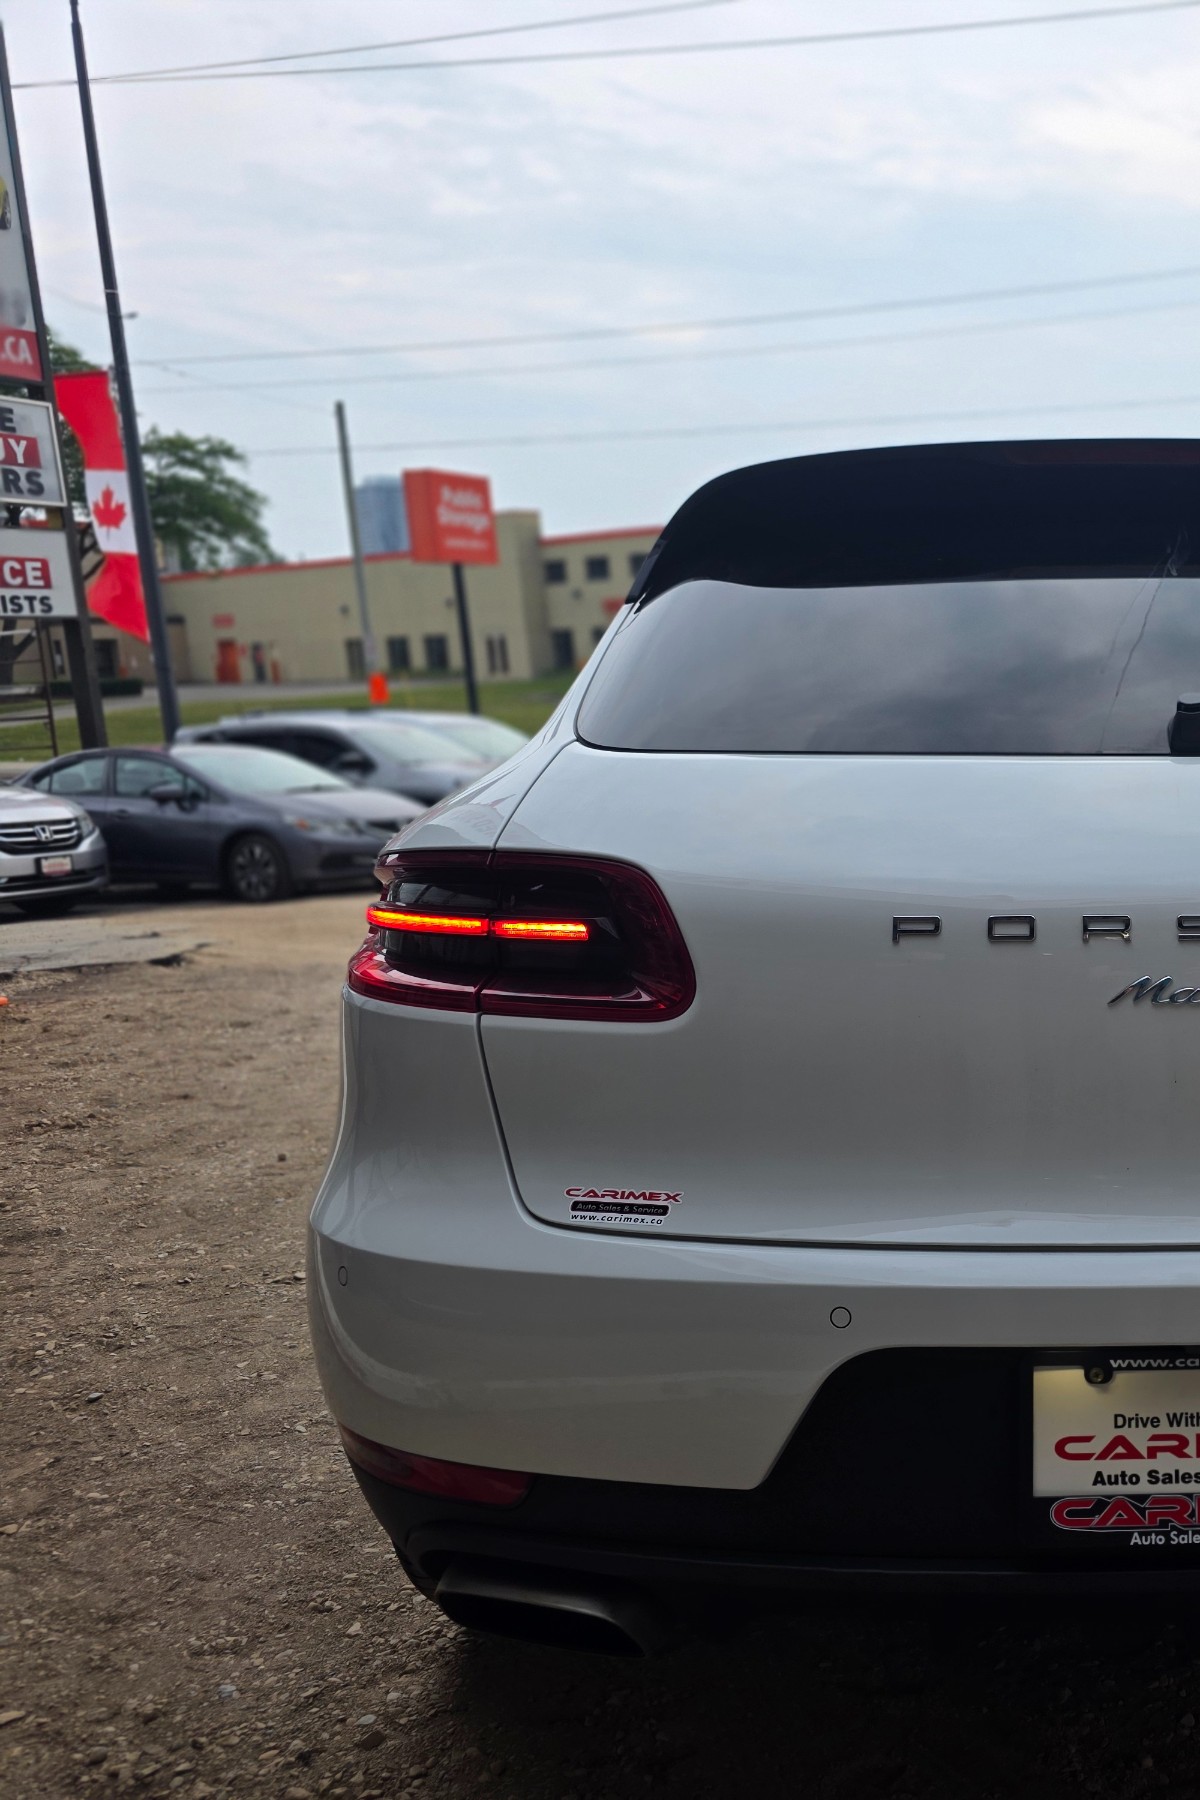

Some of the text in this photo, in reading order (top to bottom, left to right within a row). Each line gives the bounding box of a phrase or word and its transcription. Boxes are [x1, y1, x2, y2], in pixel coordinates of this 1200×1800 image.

[0, 437, 27, 464] Y
[1, 467, 45, 496] RS
[2, 560, 45, 587] CE
[0, 594, 53, 614] ISTS
[565, 1187, 682, 1203] CARIMEX
[575, 1202, 597, 1211] Auto
[599, 1203, 621, 1212] Sales
[633, 1205, 664, 1214] Service
[570, 1213, 664, 1225] www.carimex.ca
[1113, 1413, 1161, 1429] Drive
[1092, 1470, 1141, 1487] Auto
[1130, 1531, 1165, 1546] Auto
